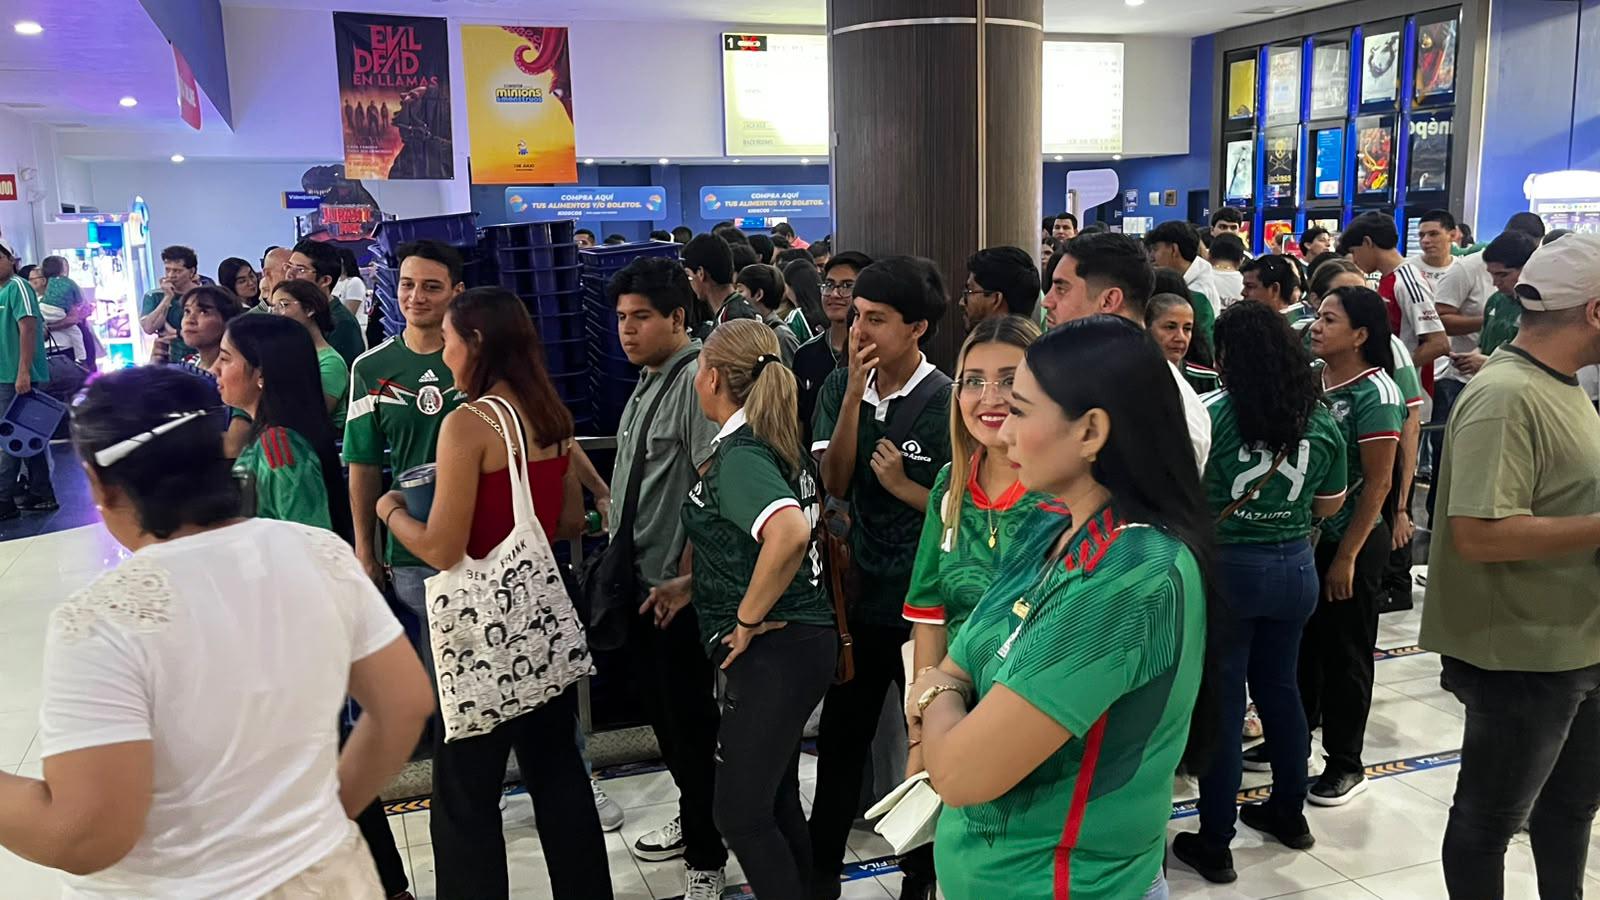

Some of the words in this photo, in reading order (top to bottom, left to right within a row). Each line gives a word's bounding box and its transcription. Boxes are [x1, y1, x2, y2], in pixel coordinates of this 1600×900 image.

[369, 25, 422, 55] EVIL
[353, 44, 420, 74] DEAD
[353, 74, 373, 86] EN
[377, 74, 439, 88] LLAMAS
[496, 88, 543, 97] minions
[595, 192, 614, 201] AQUÍ
[782, 191, 799, 199] AQUÍ
[908, 453, 932, 463] Azteca
[1231, 439, 1310, 501] 24
[466, 569, 487, 581] BEN
[500, 539, 527, 568] FRANK
[858, 861, 888, 870] FILA
